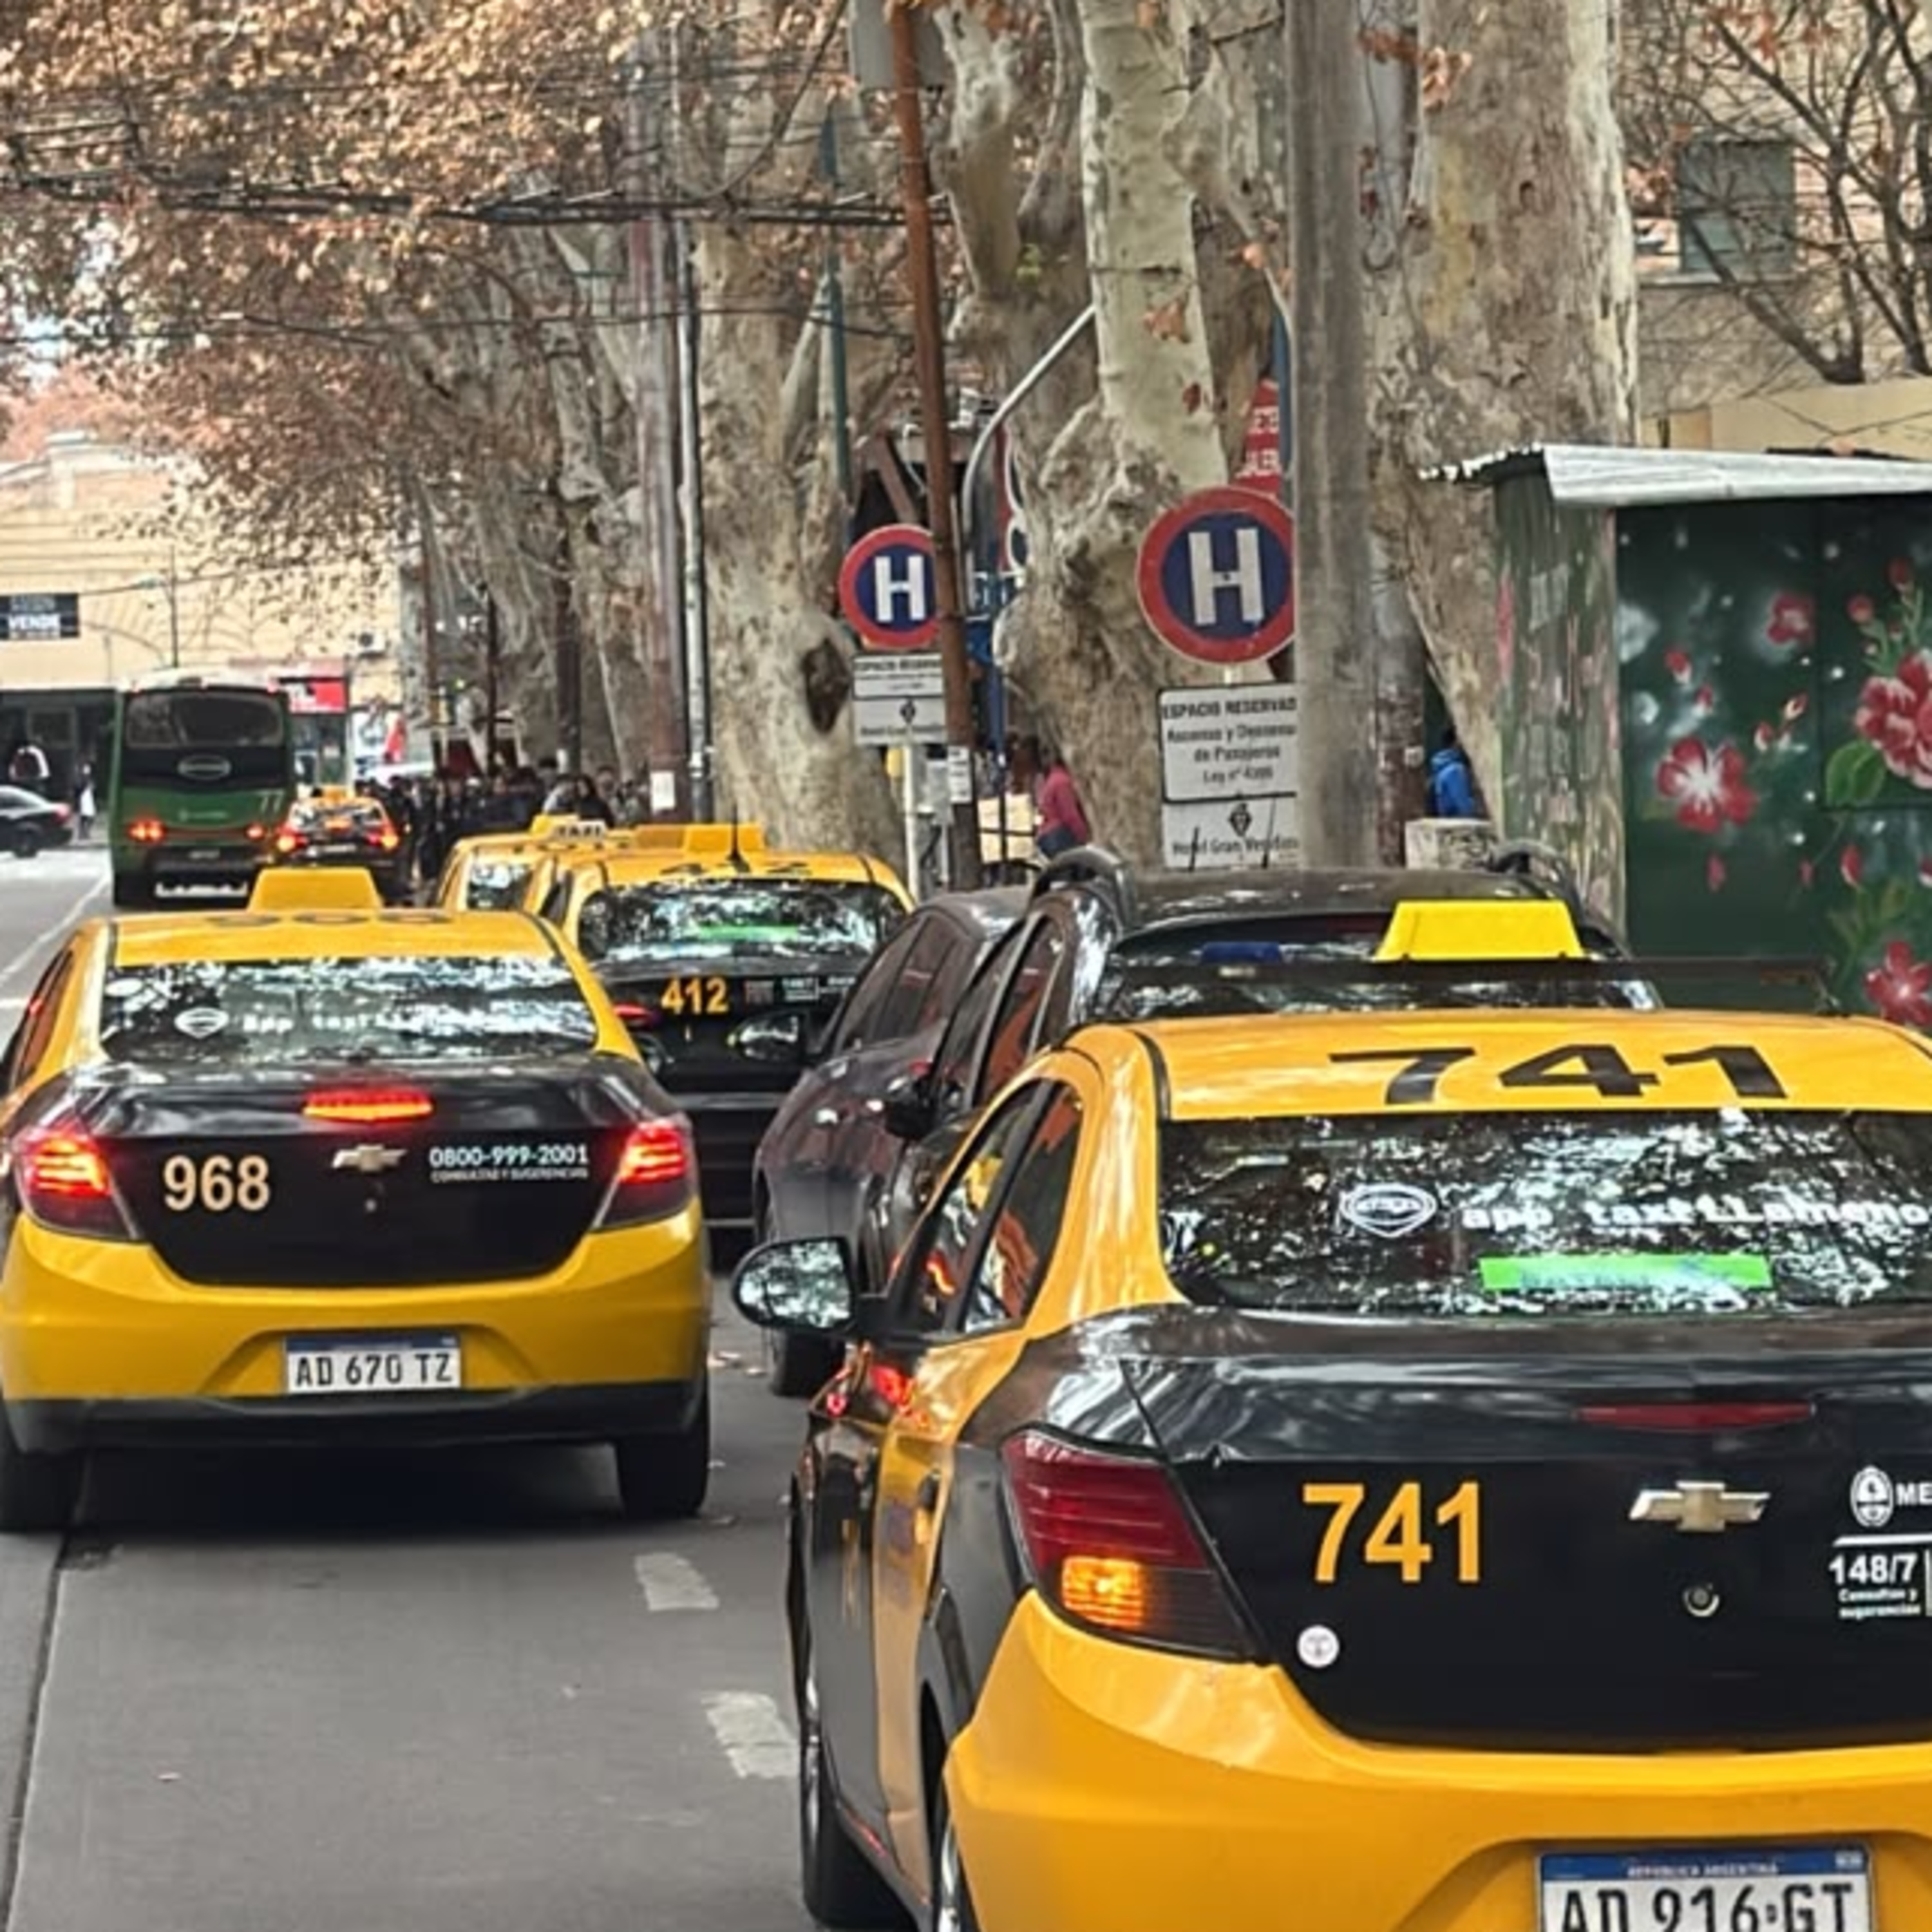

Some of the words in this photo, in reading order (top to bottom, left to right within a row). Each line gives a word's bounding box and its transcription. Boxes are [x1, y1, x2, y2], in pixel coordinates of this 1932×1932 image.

[874, 554, 926, 623] H
[1188, 527, 1264, 625] H
[1225, 697, 1297, 714] RESERVAD
[661, 974, 729, 1014] 412
[1328, 1043, 1788, 1105] 741
[429, 1144, 589, 1168] 0800-999-2001
[164, 1155, 270, 1210] 968
[296, 1356, 332, 1387] AD
[345, 1354, 402, 1385] 670
[415, 1352, 453, 1383] TZ
[1303, 1481, 1480, 1582] 741
[1829, 1552, 1918, 1585] 148/7
[1782, 1883, 1853, 1932] GT
